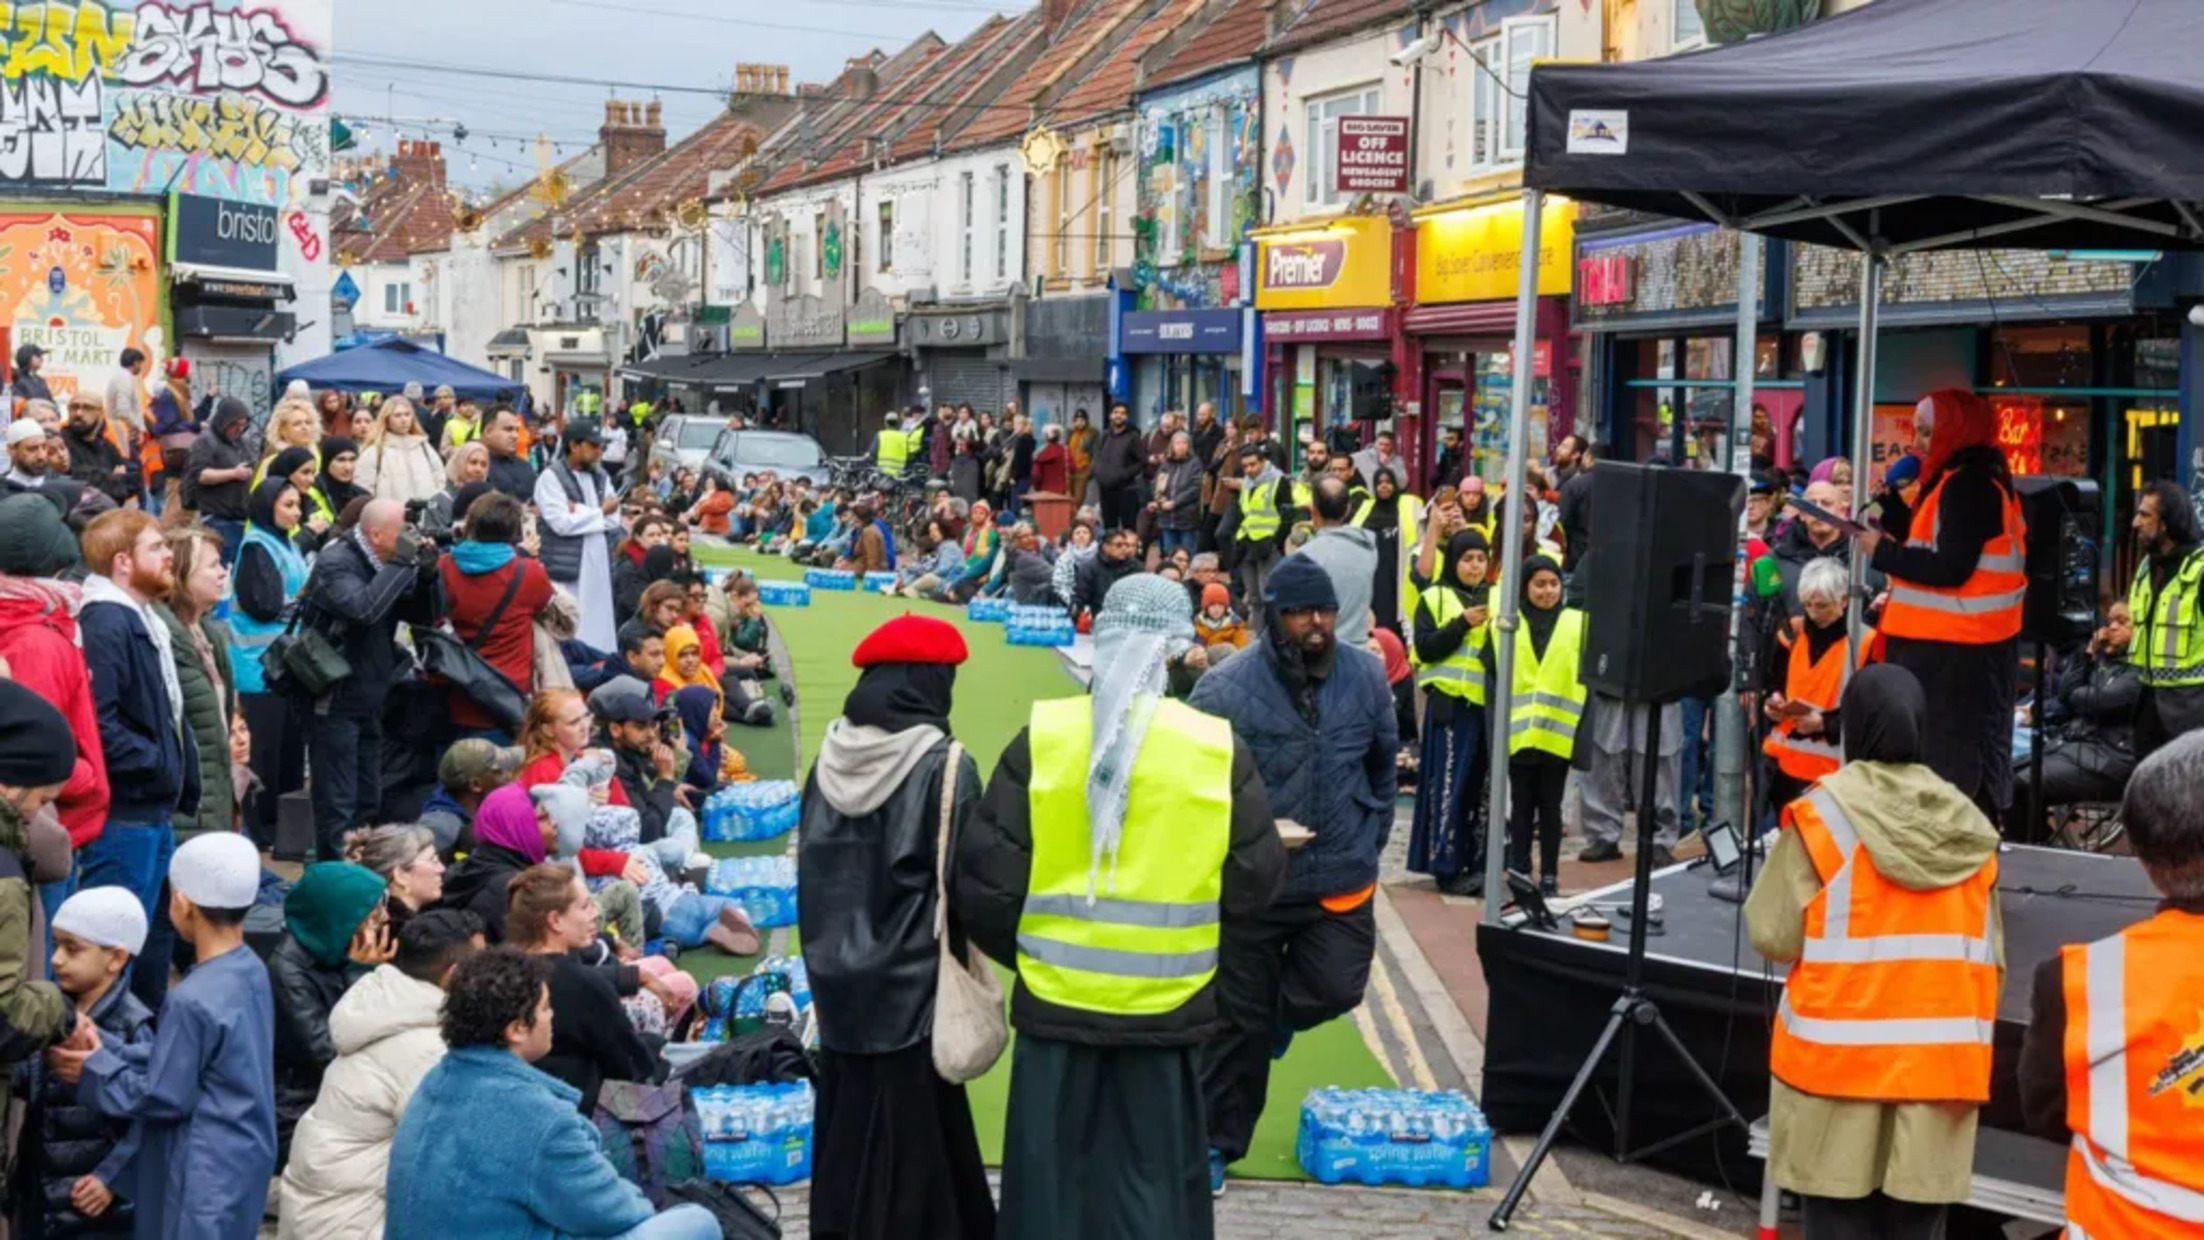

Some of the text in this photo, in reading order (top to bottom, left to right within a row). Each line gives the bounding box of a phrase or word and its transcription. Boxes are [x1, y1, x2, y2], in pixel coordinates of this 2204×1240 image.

[1346, 124, 1400, 132] BIG SAVER
[1358, 137, 1389, 149] OFF
[1341, 150, 1404, 164] LICENCE
[1341, 167, 1404, 177] NEWSAGENT
[1349, 178, 1396, 188] GROCERS
[1269, 247, 1327, 286] Premier
[1436, 253, 1449, 283] Big
[1474, 248, 1522, 274] Convenienc
[20, 327, 105, 347] BRISTOL
[64, 350, 114, 365] MART
[1999, 408, 2028, 444] Bar
[731, 1141, 772, 1159] water
[1369, 1144, 1409, 1163] spring
[1413, 1143, 1454, 1161] water
